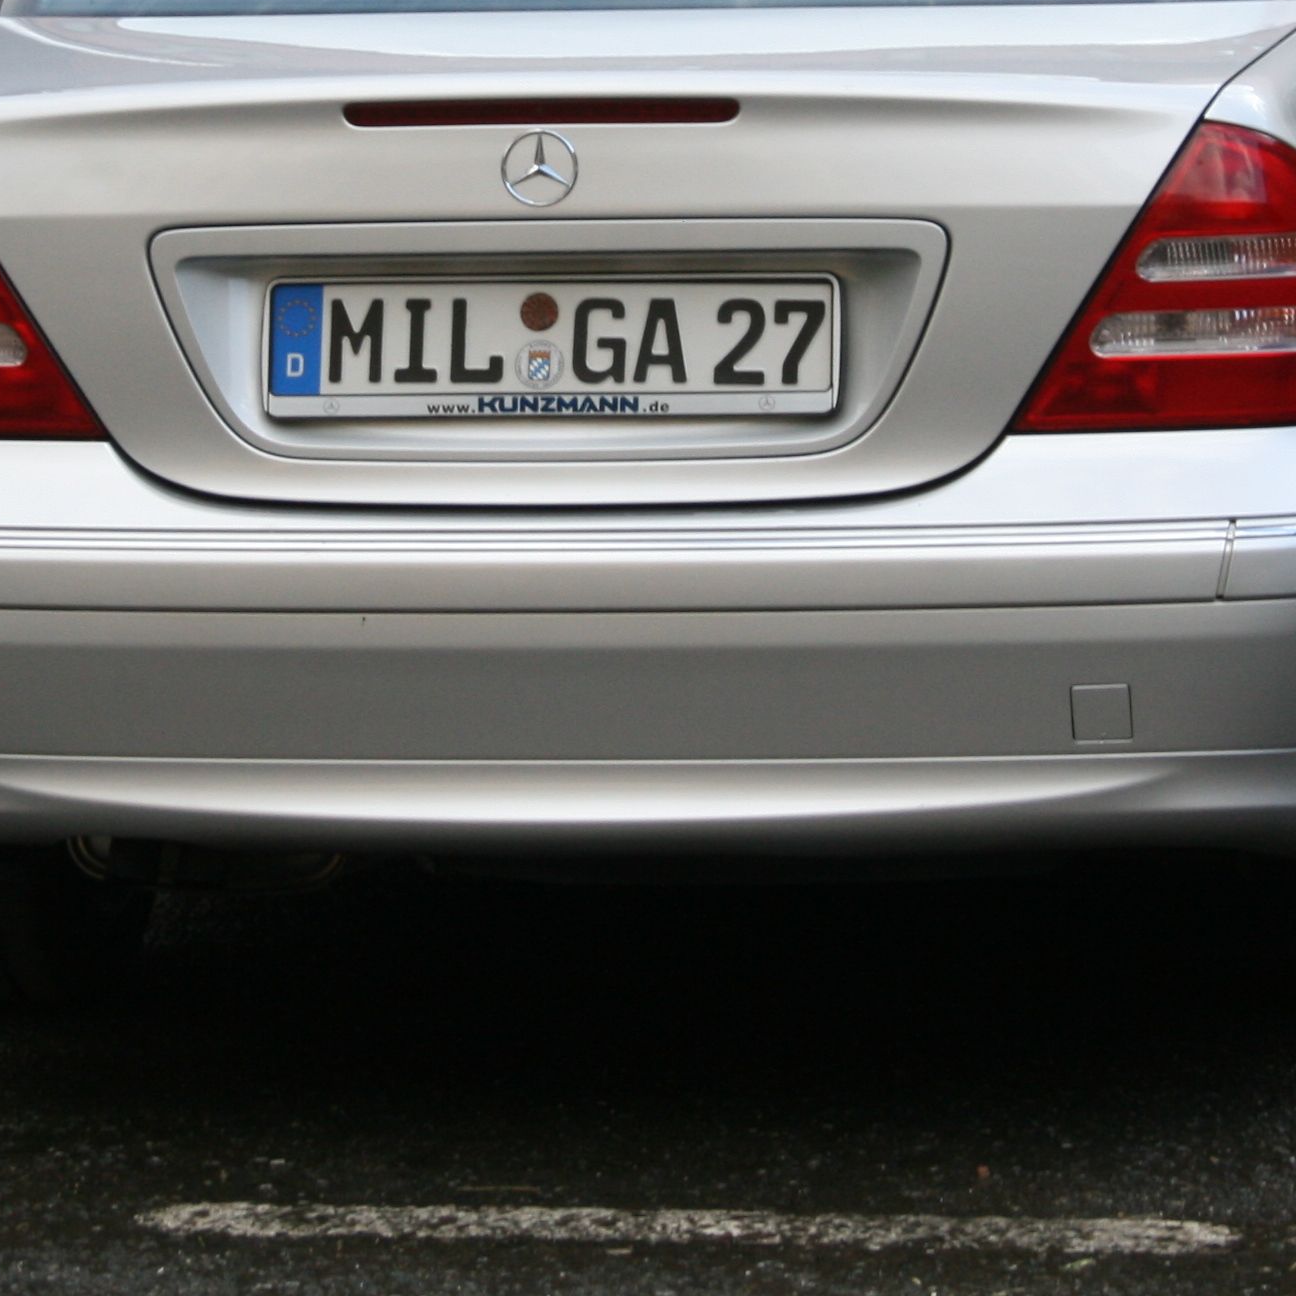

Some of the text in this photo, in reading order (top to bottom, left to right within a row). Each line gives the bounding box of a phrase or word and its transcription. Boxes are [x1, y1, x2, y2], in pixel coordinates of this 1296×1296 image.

[328, 298, 505, 384] MIL
[571, 297, 688, 384] GA
[712, 298, 827, 386] 27
[286, 353, 305, 377] D
[426, 396, 670, 414] www.KUNZMANN.de
